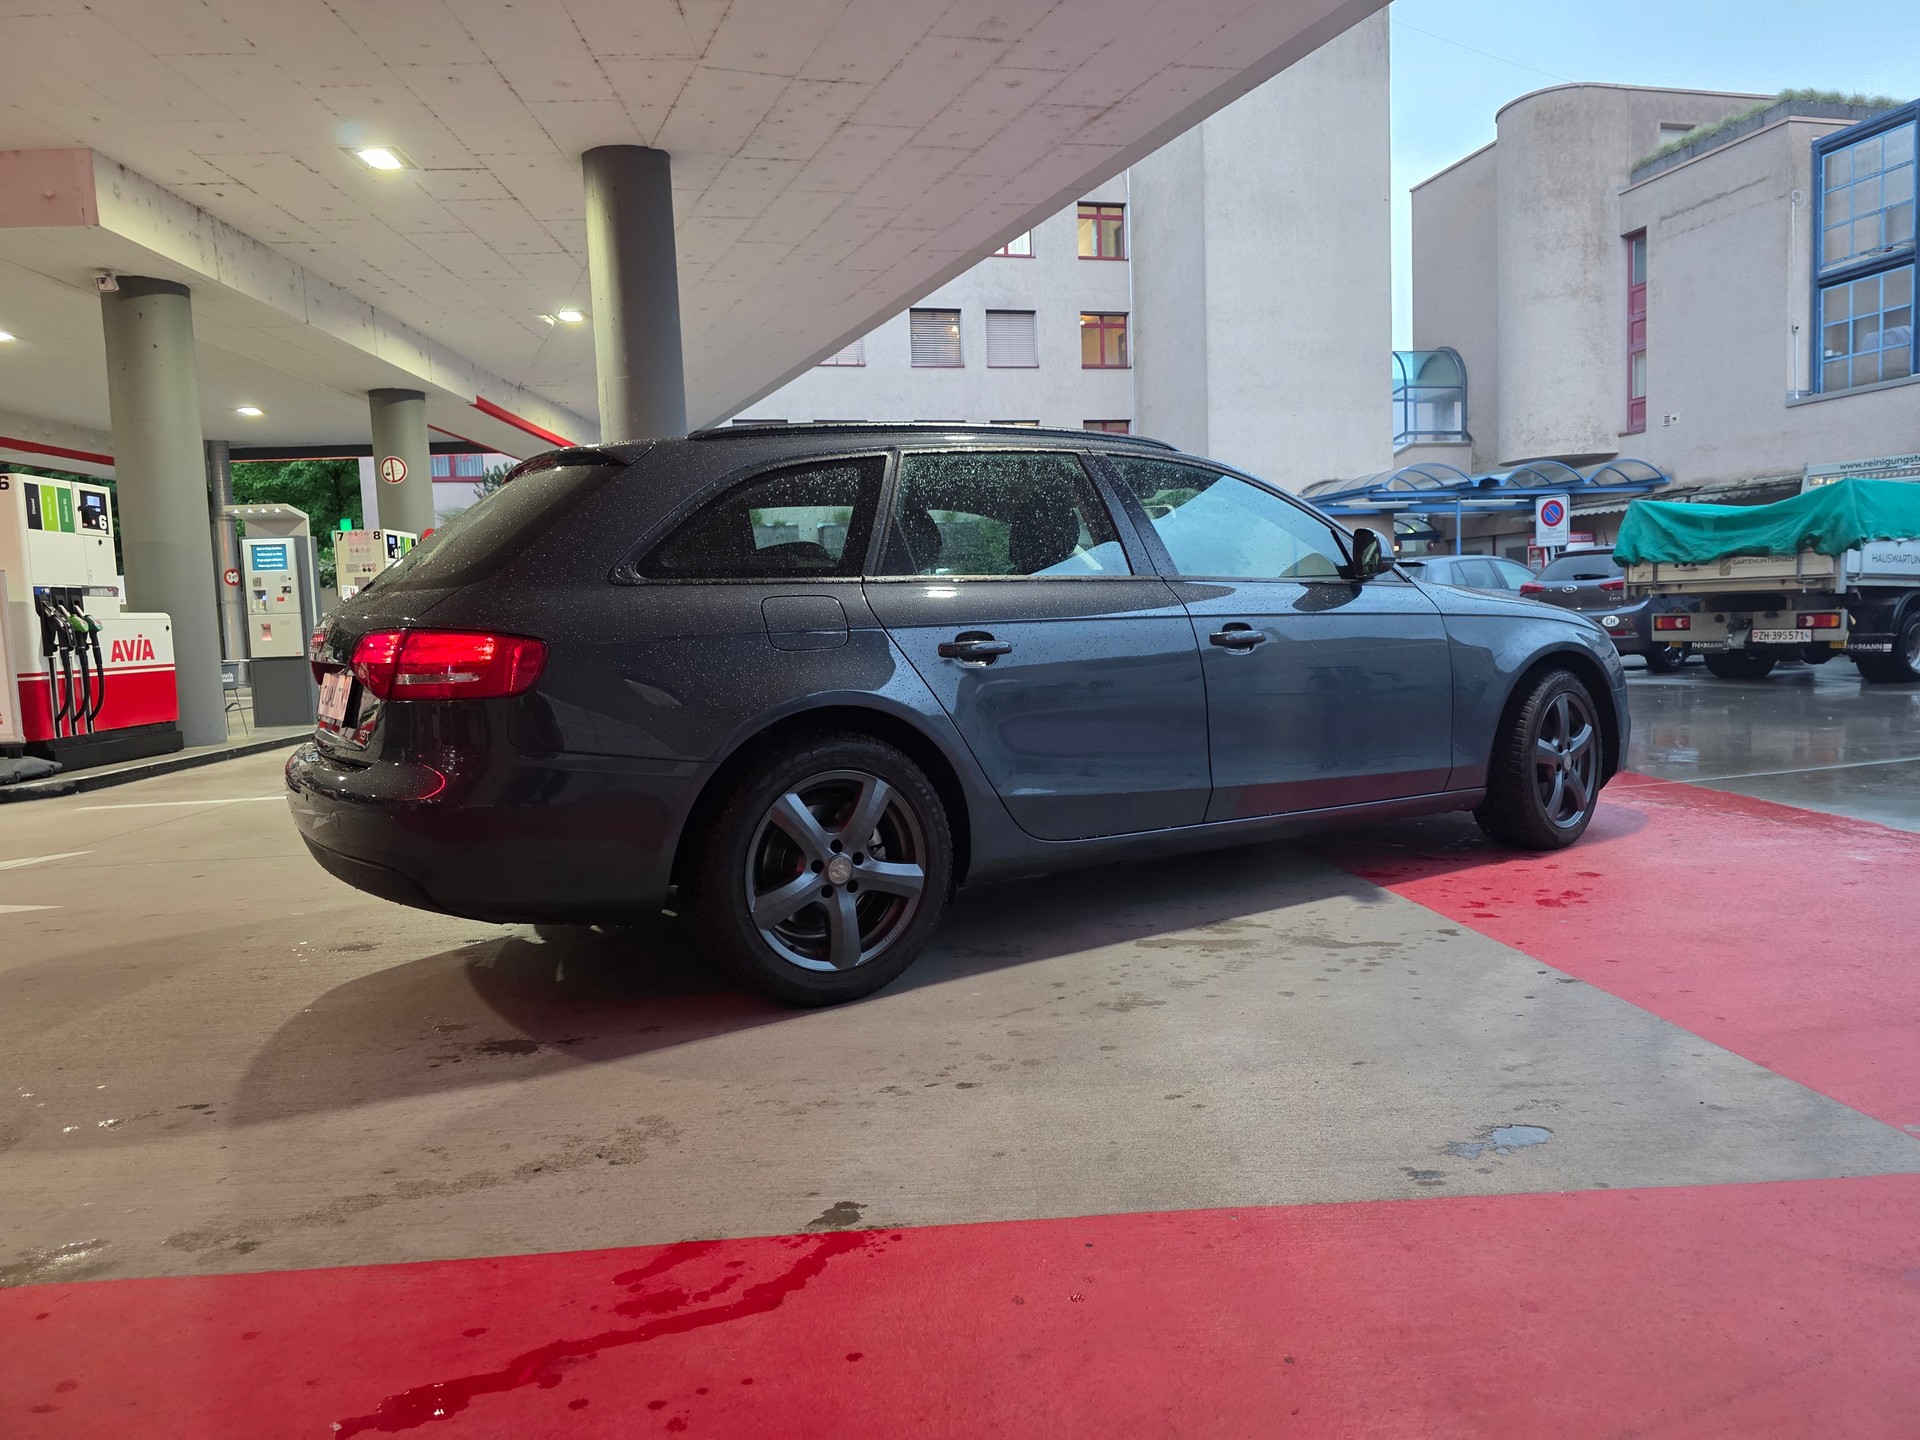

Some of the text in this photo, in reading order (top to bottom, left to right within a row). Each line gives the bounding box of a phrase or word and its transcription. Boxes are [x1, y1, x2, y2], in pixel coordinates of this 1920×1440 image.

[0, 475, 10, 490] 6
[98, 514, 108, 530] 6
[336, 532, 344, 541] 7
[373, 531, 381, 540] 8
[1605, 617, 1616, 626] CH
